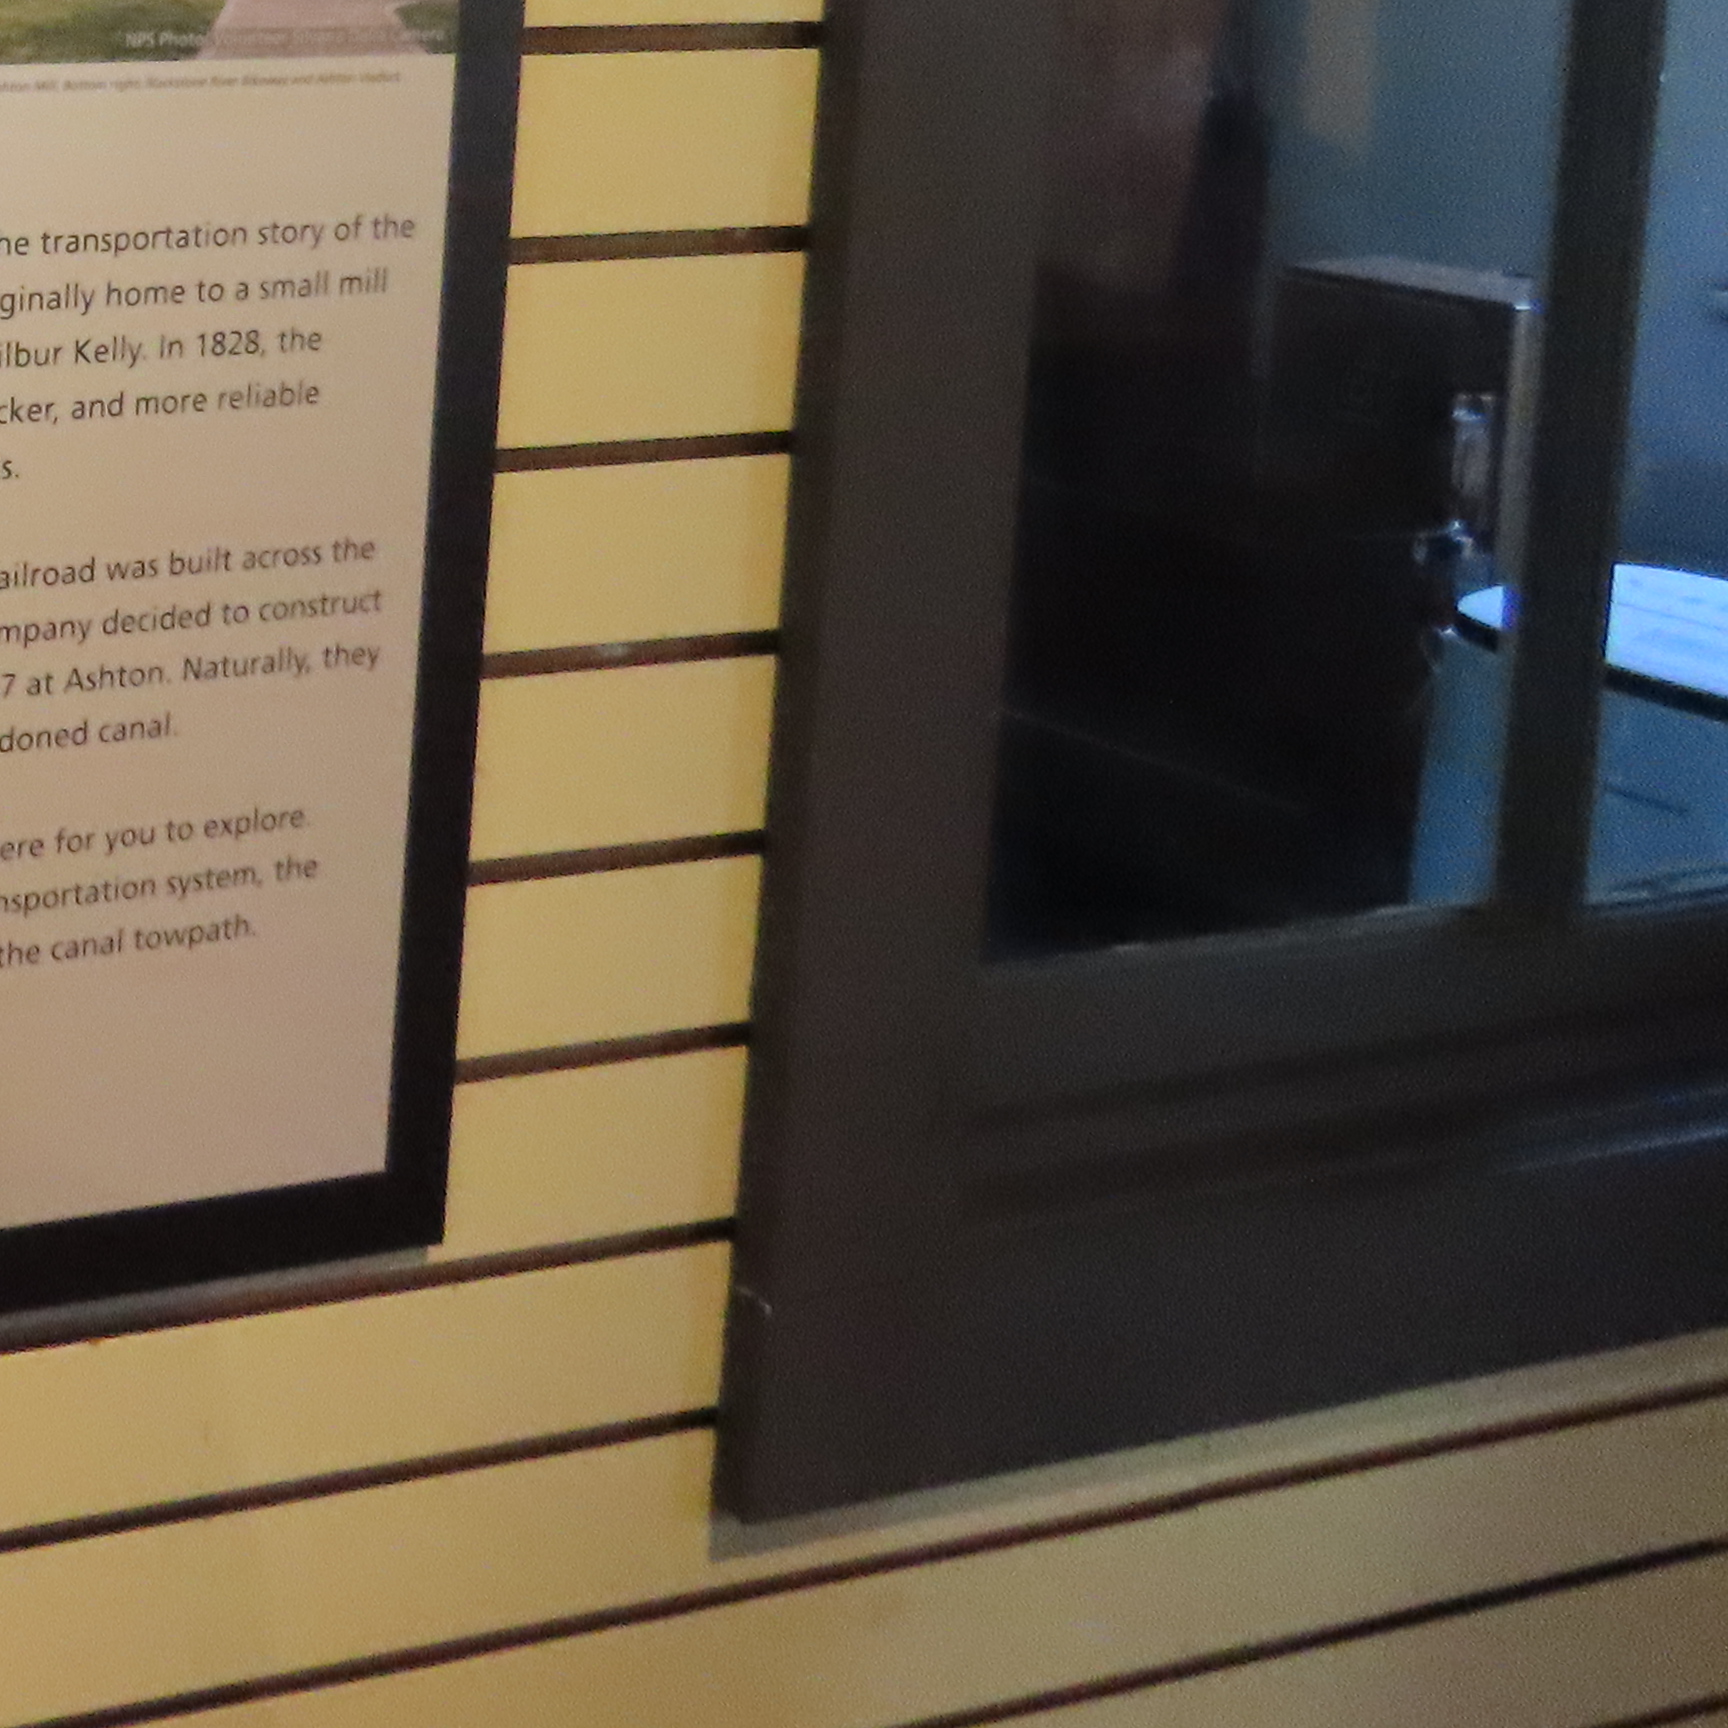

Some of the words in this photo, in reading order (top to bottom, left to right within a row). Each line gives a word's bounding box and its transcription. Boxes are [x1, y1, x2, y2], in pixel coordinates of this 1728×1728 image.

[40, 225, 248, 257] transportation
[258, 222, 324, 249] story
[334, 214, 362, 243] of
[372, 214, 416, 239] the
[159, 335, 185, 359] In
[278, 327, 322, 353] the
[106, 558, 159, 581] was
[169, 547, 232, 577] built
[242, 546, 323, 571] across
[332, 537, 375, 562] the
[50, 928, 124, 962] canal
